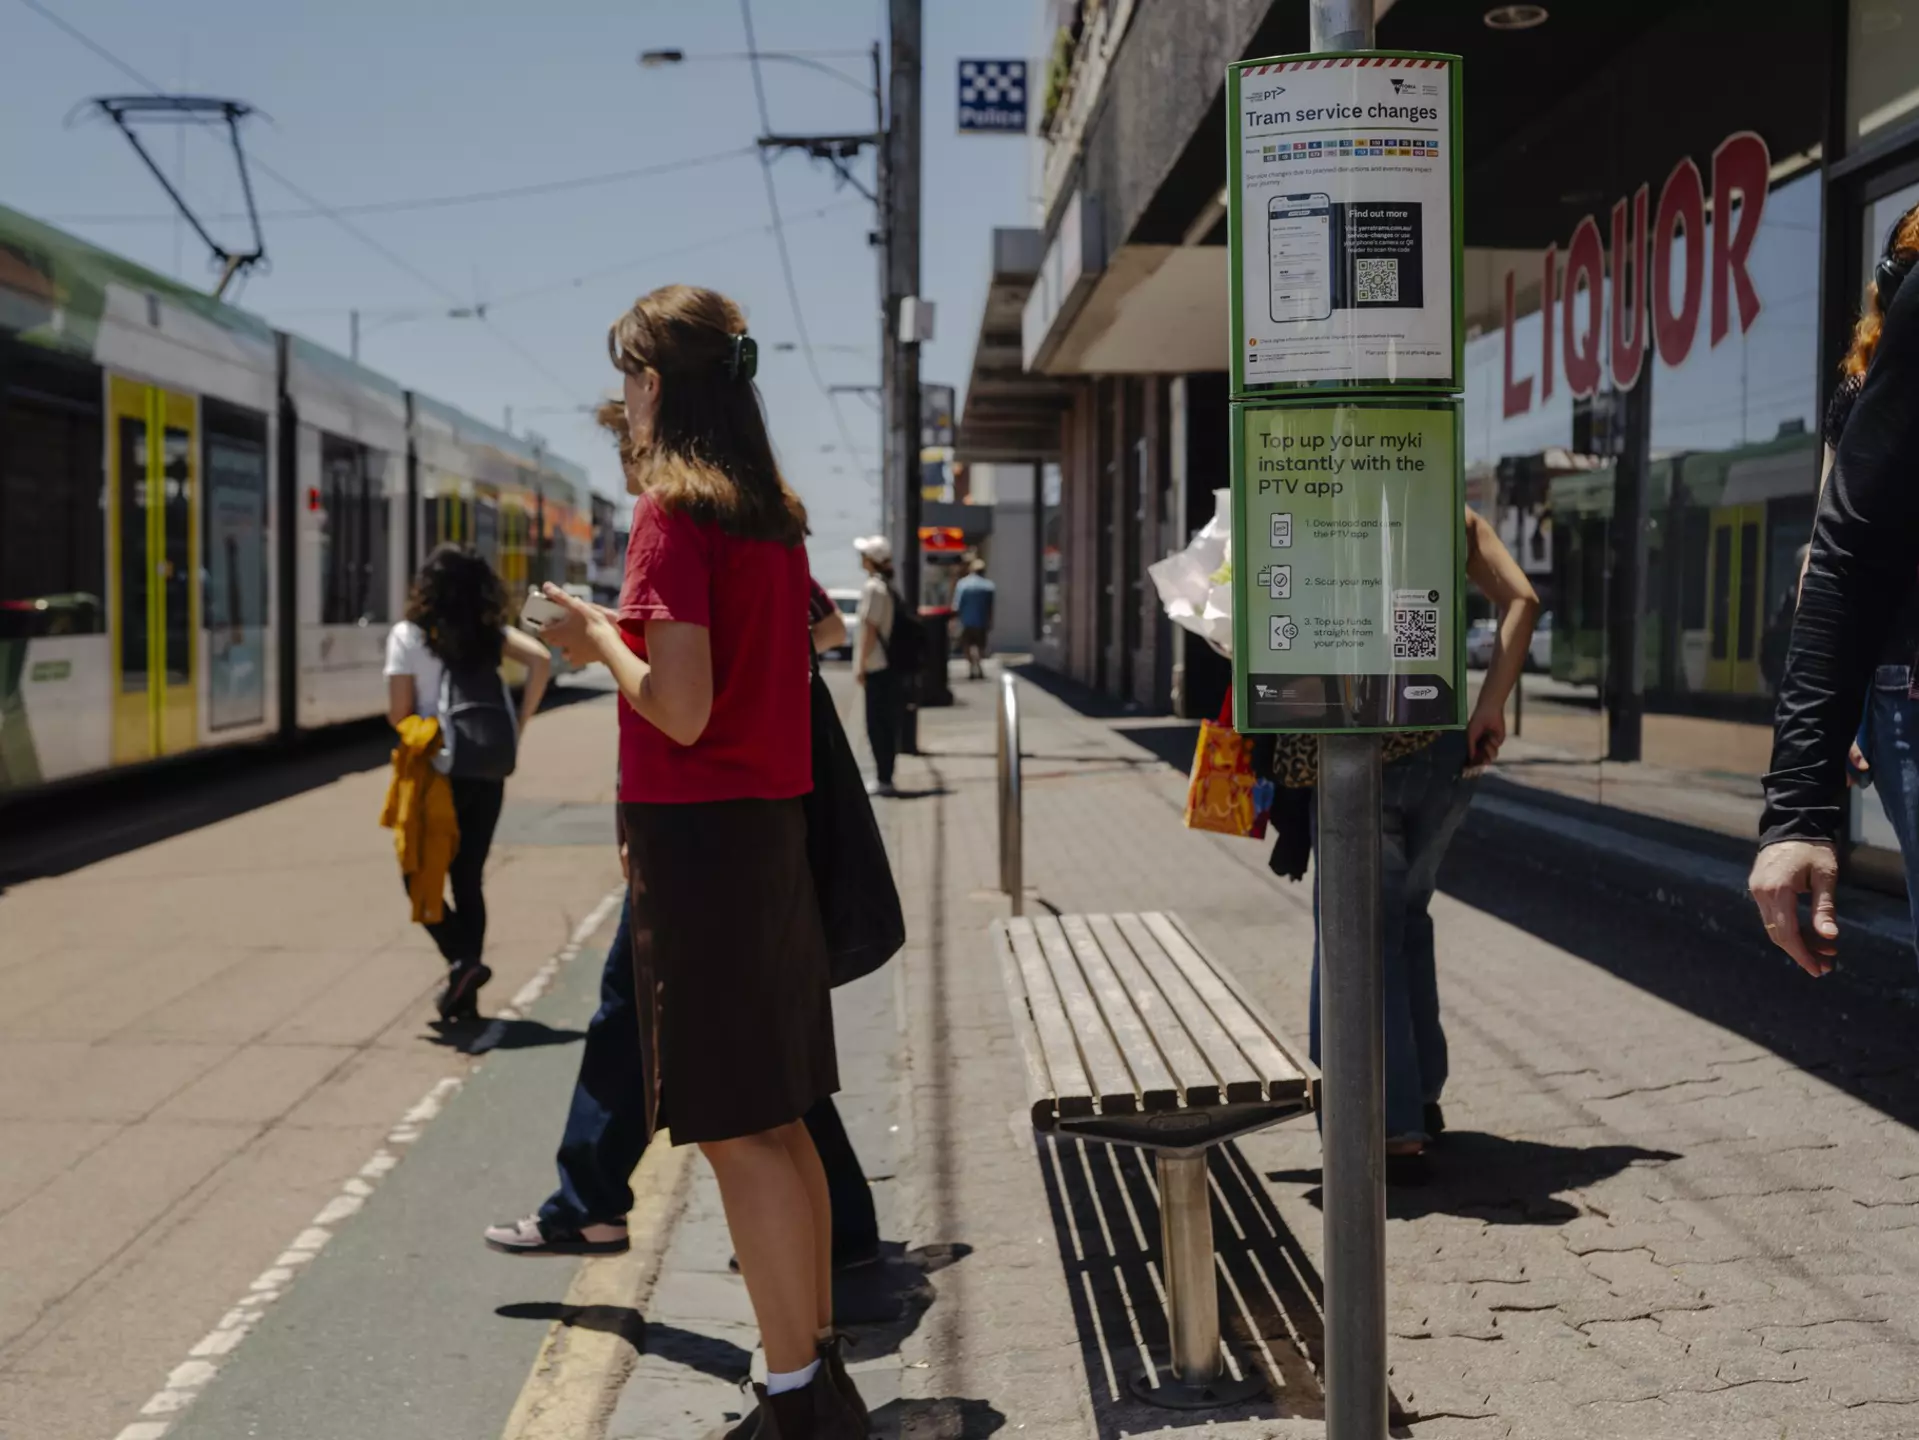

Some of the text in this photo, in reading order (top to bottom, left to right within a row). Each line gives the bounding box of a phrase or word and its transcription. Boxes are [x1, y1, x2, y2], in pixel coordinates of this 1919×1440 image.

[960, 107, 1025, 127] Police
[1246, 102, 1438, 127] Tram service changes
[1268, 170, 1292, 178] changes
[1312, 167, 1336, 175] planned
[1348, 210, 1408, 218] Find out more
[1503, 130, 1771, 420] LIQUOR
[1259, 432, 1422, 452] Top up your myki
[1258, 454, 1425, 475] instantly with the
[1258, 478, 1344, 498] PTV app
[1313, 519, 1360, 528] Download
[1360, 519, 1379, 528] and
[1313, 530, 1369, 540] the PTV app
[1305, 577, 1313, 586] 2.
[1339, 578, 1360, 588] your
[1305, 617, 1372, 628] 3. Top up funds
[1313, 627, 1374, 639] straight from
[1313, 639, 1365, 650] your phone
